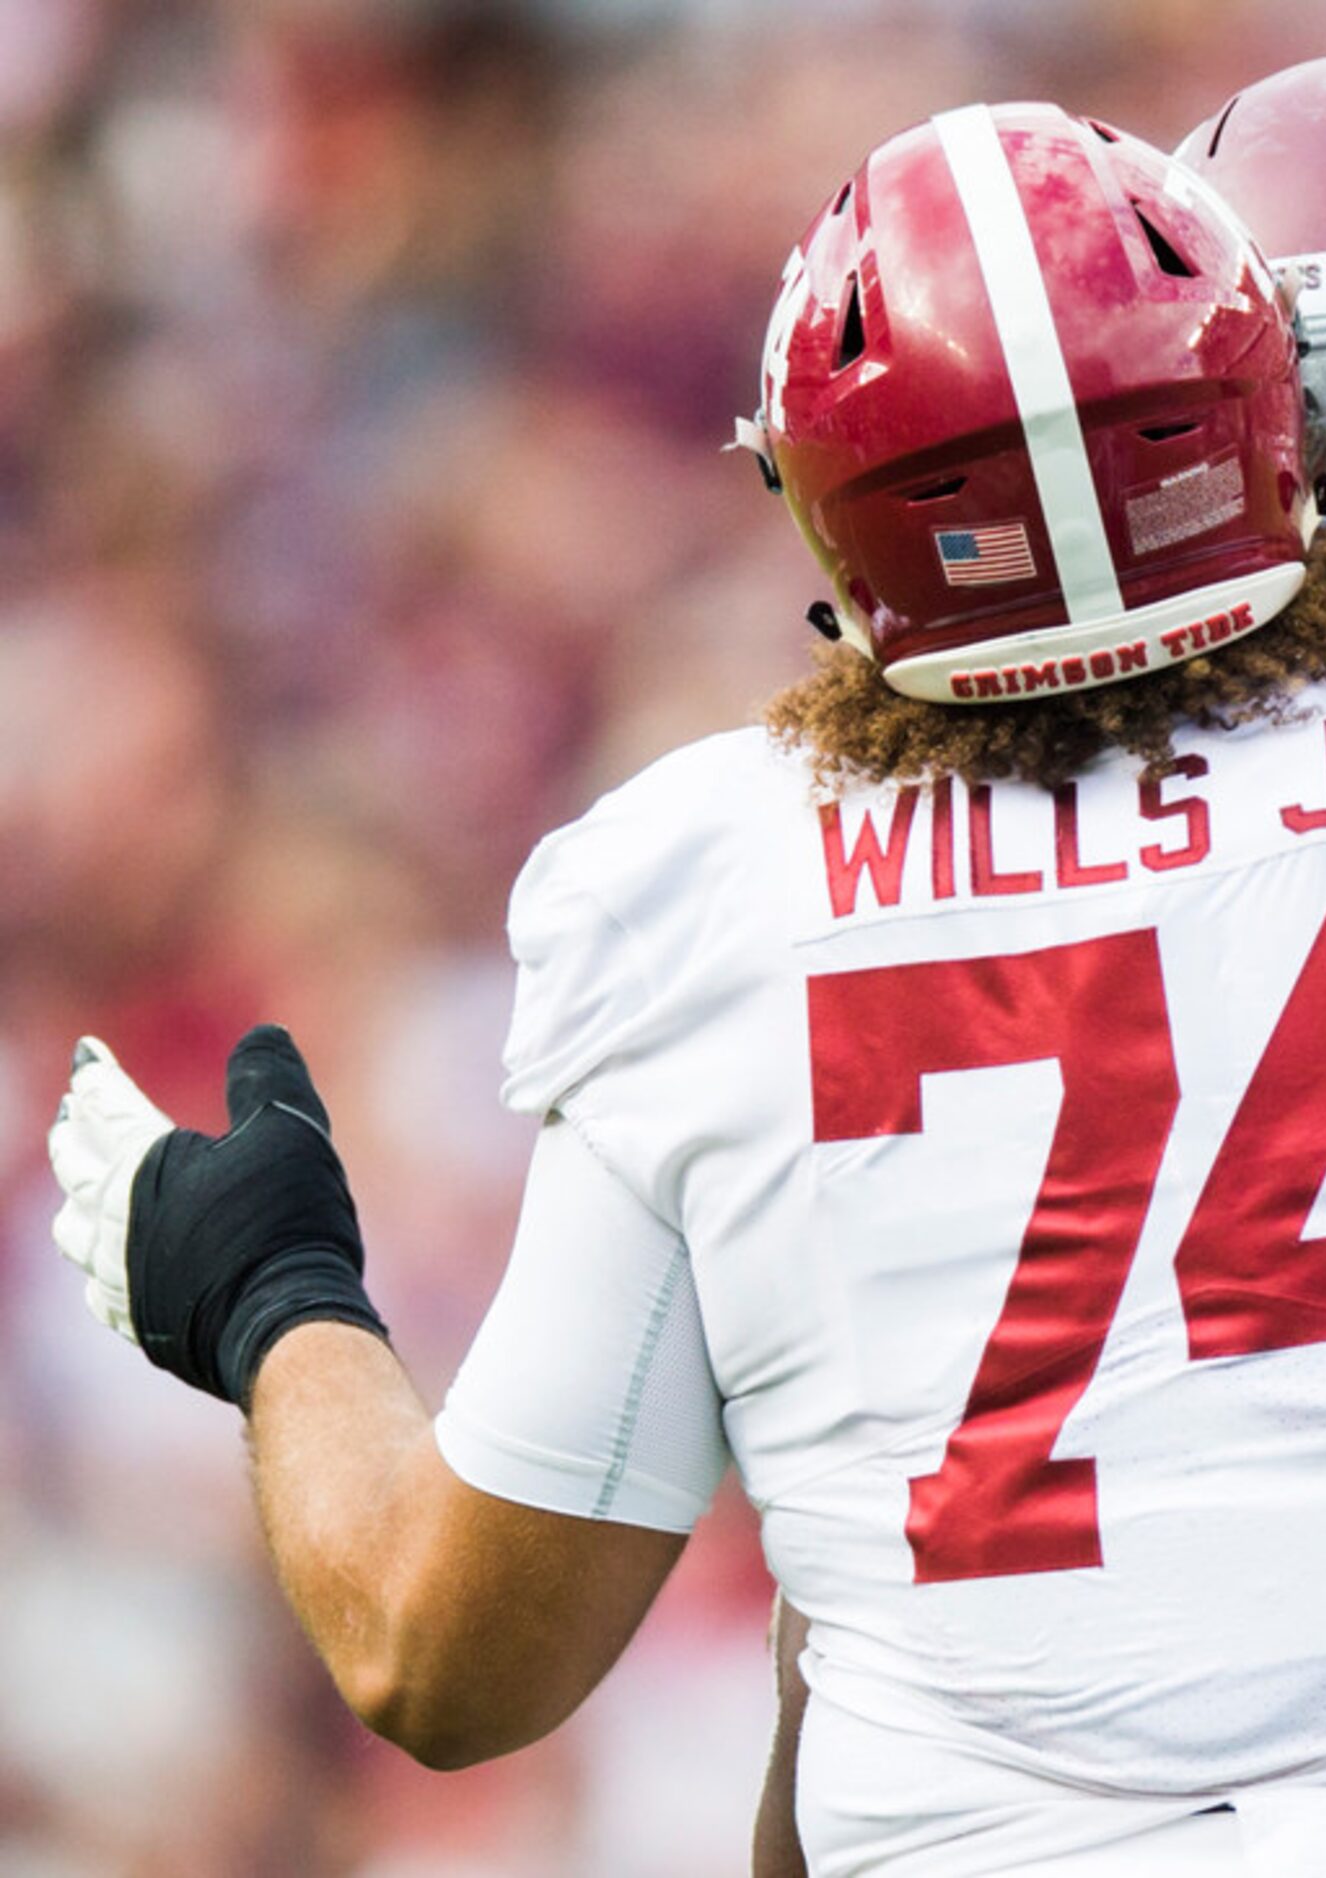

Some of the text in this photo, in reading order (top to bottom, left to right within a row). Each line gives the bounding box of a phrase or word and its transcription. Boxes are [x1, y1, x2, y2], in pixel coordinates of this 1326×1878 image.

[949, 602, 1255, 700] CRIMSON TIDE
[818, 752, 1211, 918] WILLS
